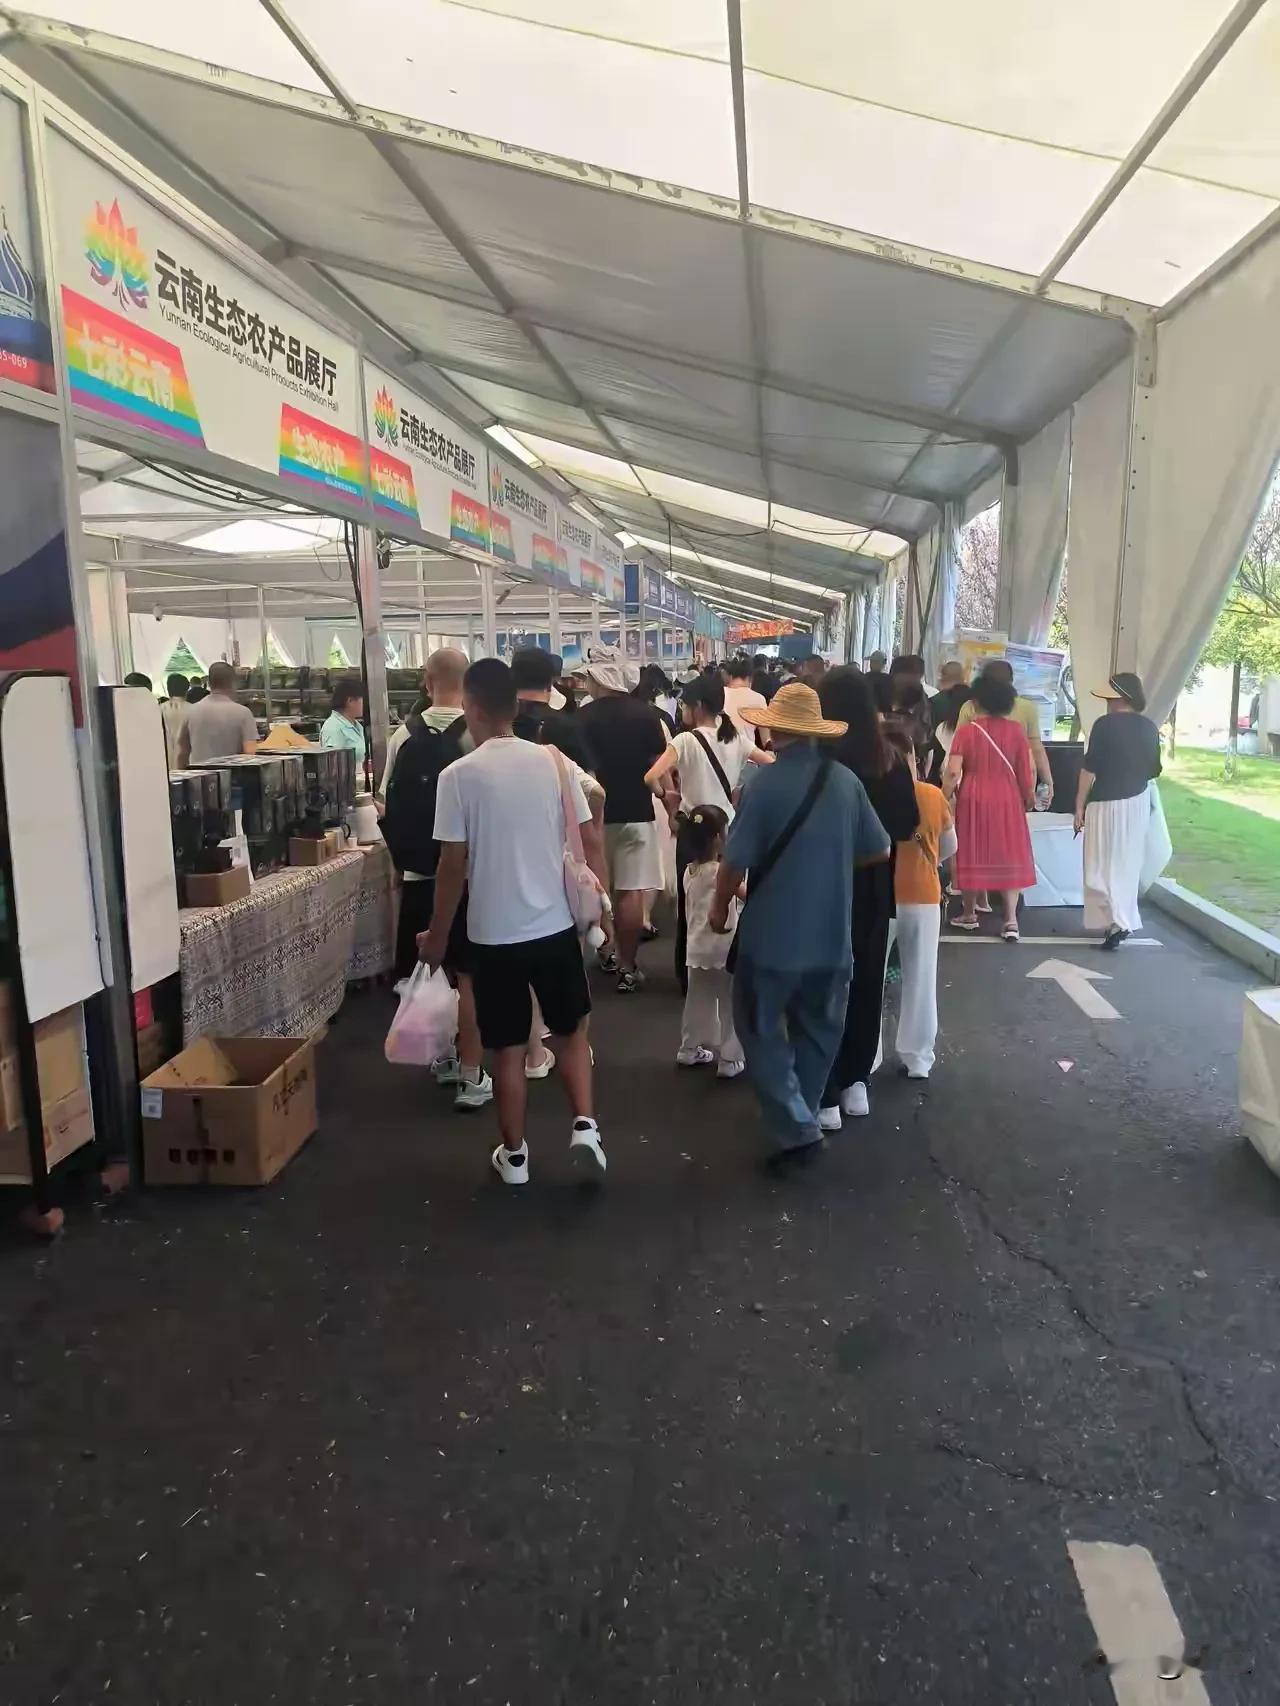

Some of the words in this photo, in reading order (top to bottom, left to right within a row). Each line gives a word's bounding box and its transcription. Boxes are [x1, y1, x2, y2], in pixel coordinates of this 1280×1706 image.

[75, 319, 175, 413] 七彩云南
[154, 248, 337, 396] 云南生态农产品展厅
[160, 303, 192, 335] Yunnan
[193, 323, 231, 356] Ecological
[232, 346, 271, 379] Agricultural
[271, 367, 299, 393] Products
[299, 383, 328, 407] Exhibition
[399, 407, 476, 481] 云南生态农产品展厅
